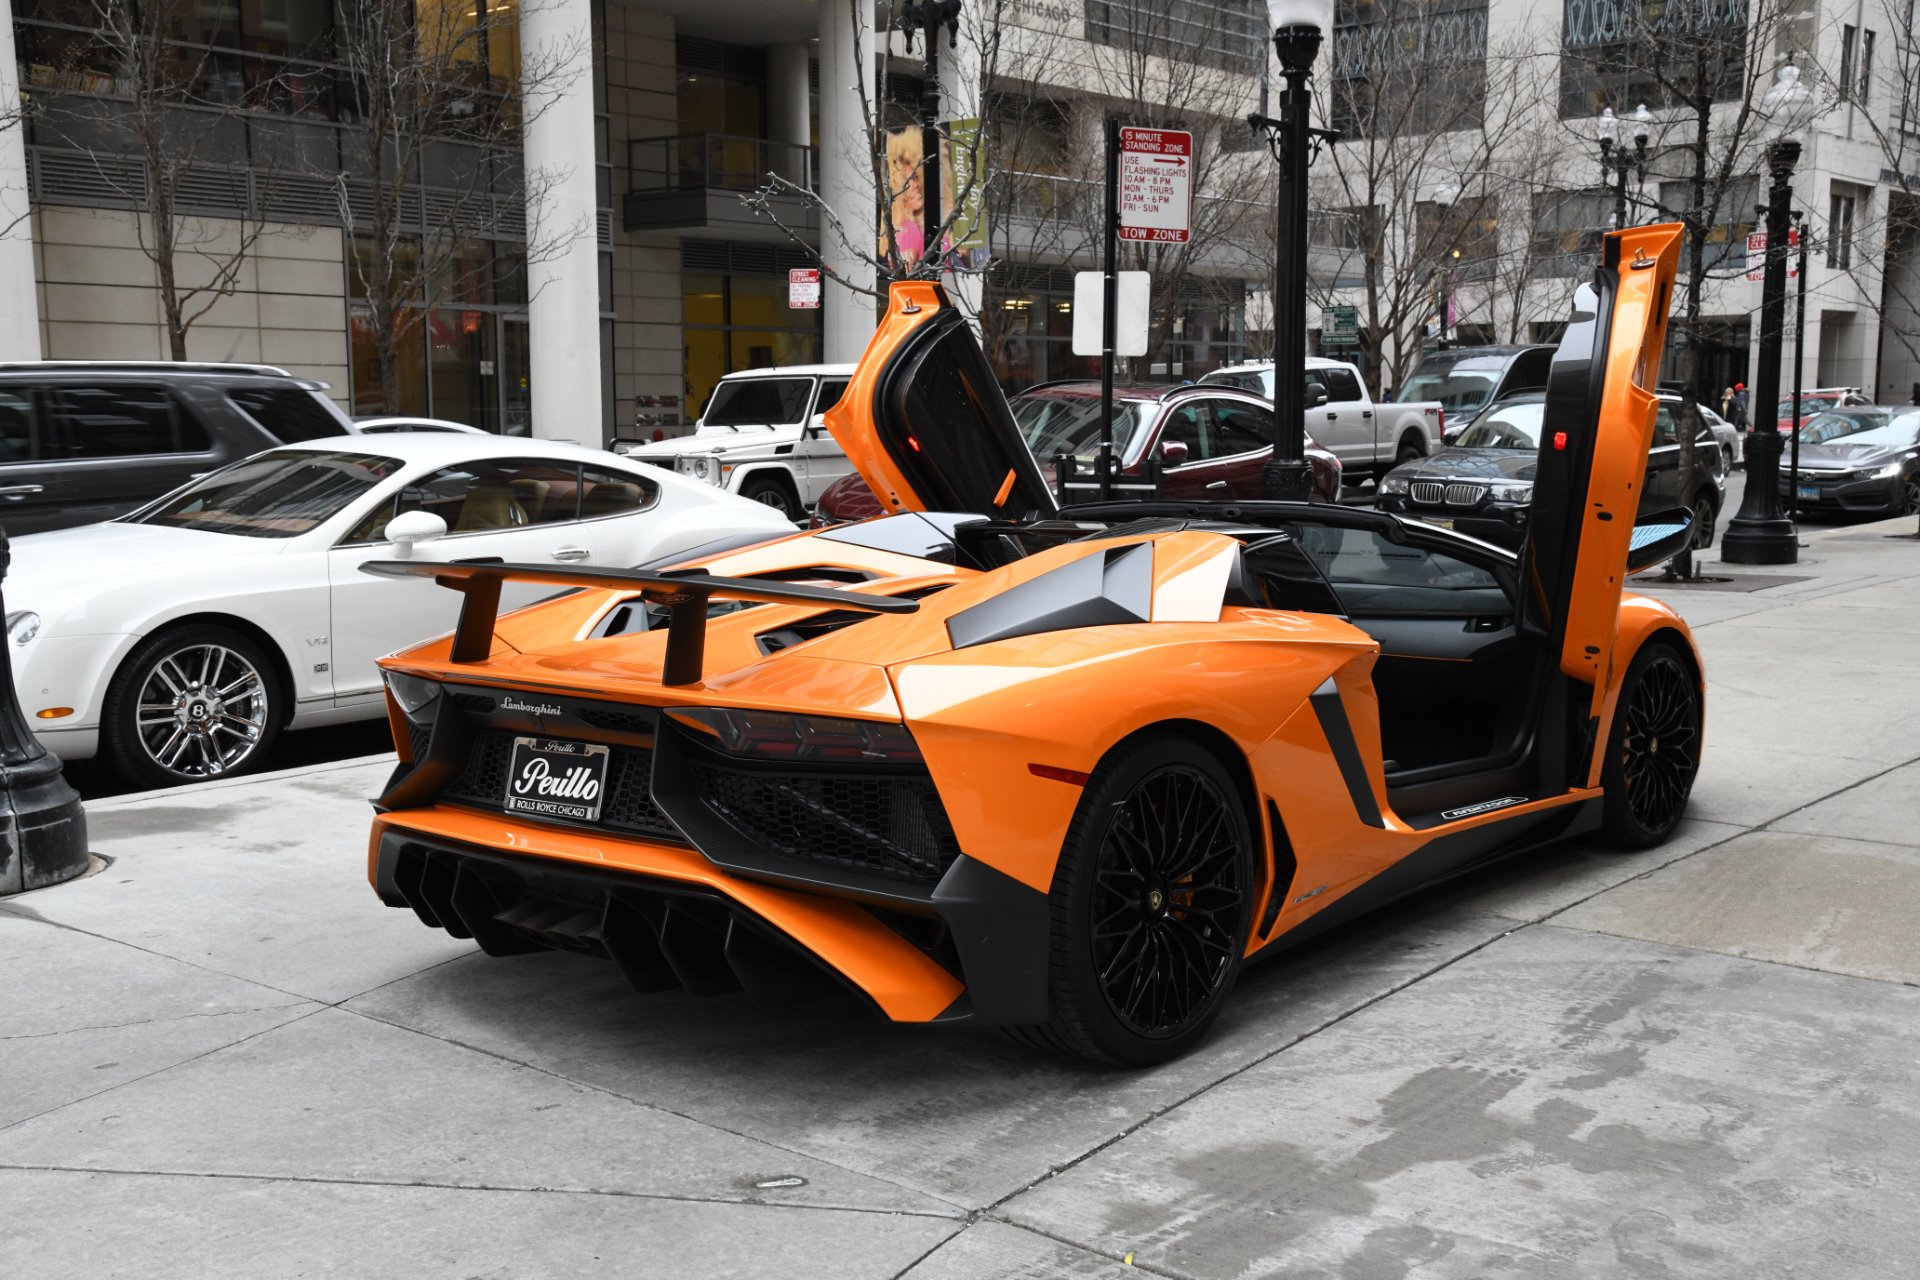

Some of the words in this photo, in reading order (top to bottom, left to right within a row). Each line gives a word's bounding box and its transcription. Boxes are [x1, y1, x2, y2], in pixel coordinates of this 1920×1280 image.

[1125, 132, 1133, 140] 15
[1135, 132, 1162, 142] MINUTE
[1125, 142, 1161, 152] STANDING
[1164, 144, 1184, 153] ZONE
[1124, 156, 1139, 164] USE
[1124, 165, 1160, 176] FLASHING
[1161, 168, 1187, 178] LIGHTS
[1124, 174, 1132, 183] 10
[1133, 175, 1145, 183] AM
[1160, 177, 1171, 185] PM
[1124, 184, 1140, 193] MON
[1149, 186, 1174, 195] THURS
[1124, 194, 1132, 202] 10
[1132, 194, 1144, 202] AM
[1152, 195, 1157, 203] 6
[1158, 196, 1170, 204] PM
[1123, 203, 1136, 211] FRI
[1143, 204, 1159, 212] SUN
[1123, 227, 1147, 239] TOW
[1153, 229, 1183, 240] ZONE
[500, 697, 562, 716] Lamborghini
[544, 740, 576, 753] Perillo
[514, 757, 599, 801] Perillo
[516, 800, 536, 811] ROLLS
[536, 802, 557, 814] ROYCE
[557, 805, 585, 817] CHICAGO
